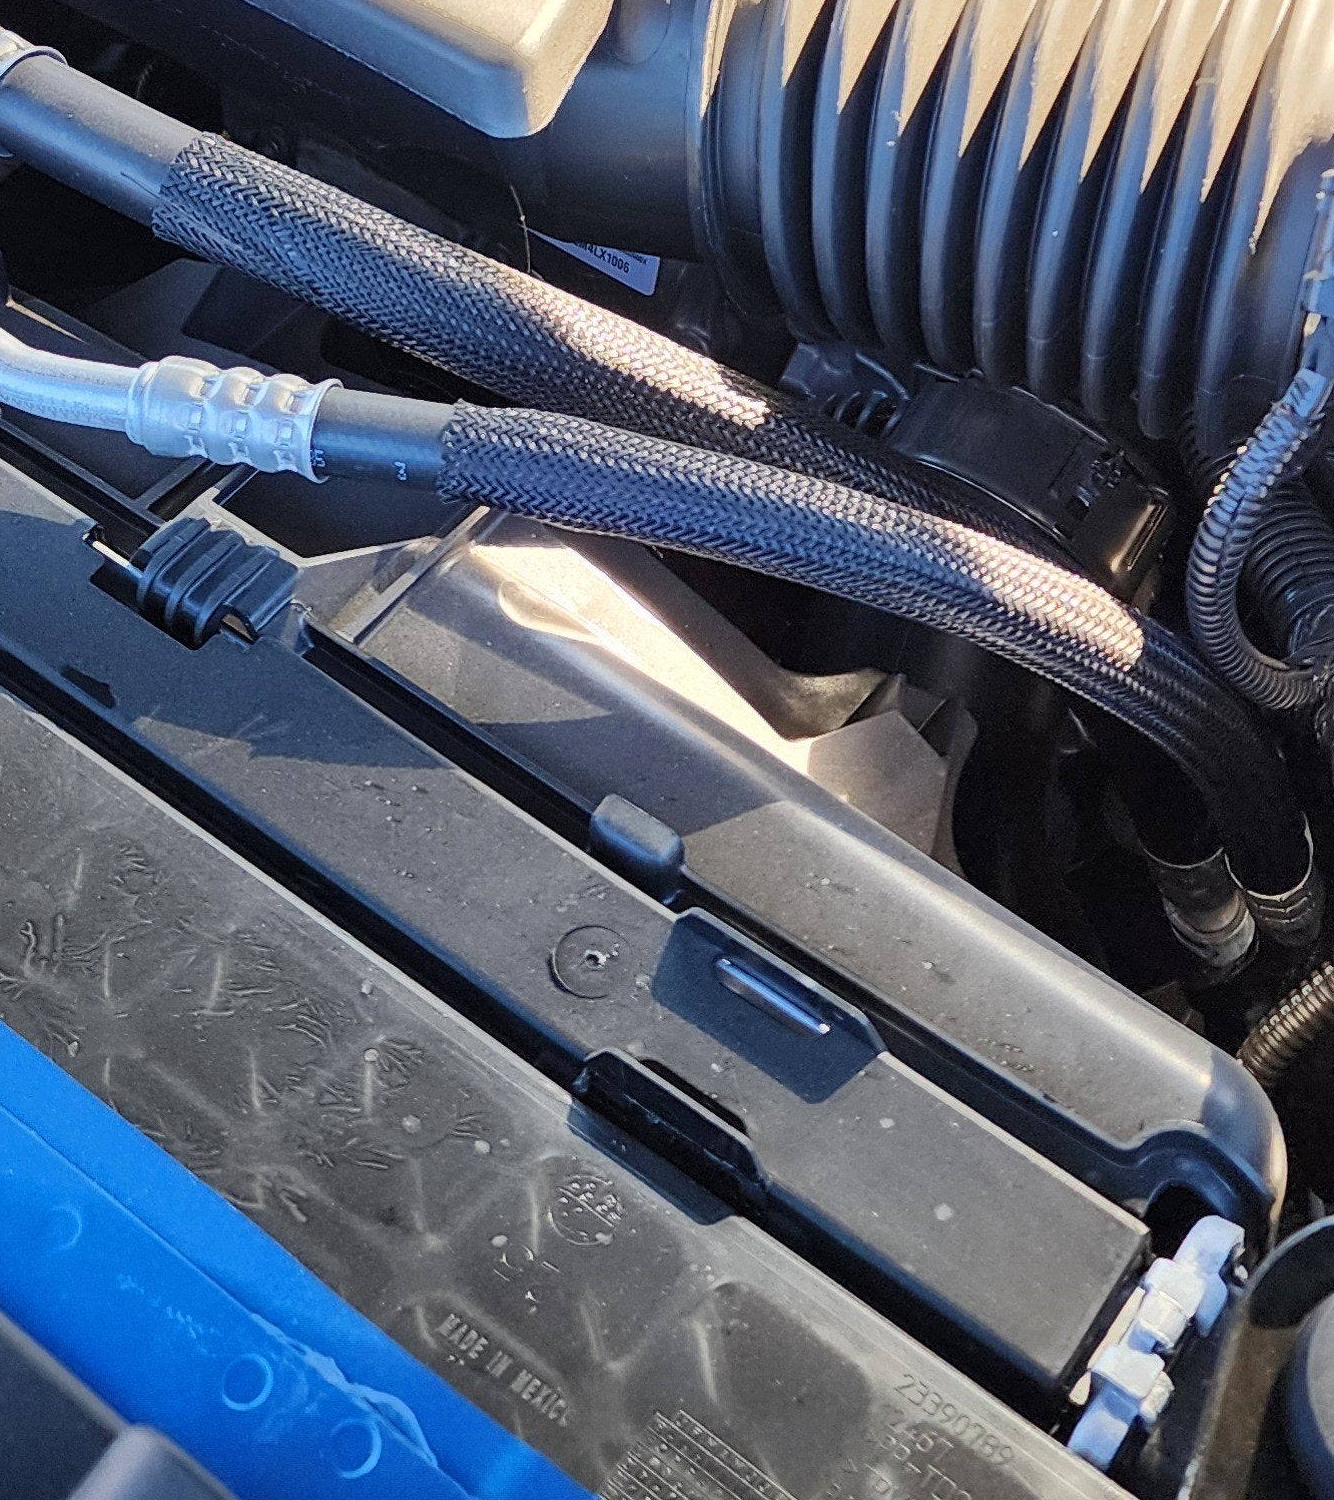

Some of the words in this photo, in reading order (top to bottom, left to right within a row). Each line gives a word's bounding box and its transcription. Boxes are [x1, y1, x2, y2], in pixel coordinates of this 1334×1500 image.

[436, 1313, 489, 1360] MADE
[485, 1350, 514, 1379] IN
[894, 1373, 1014, 1466] 23390789
